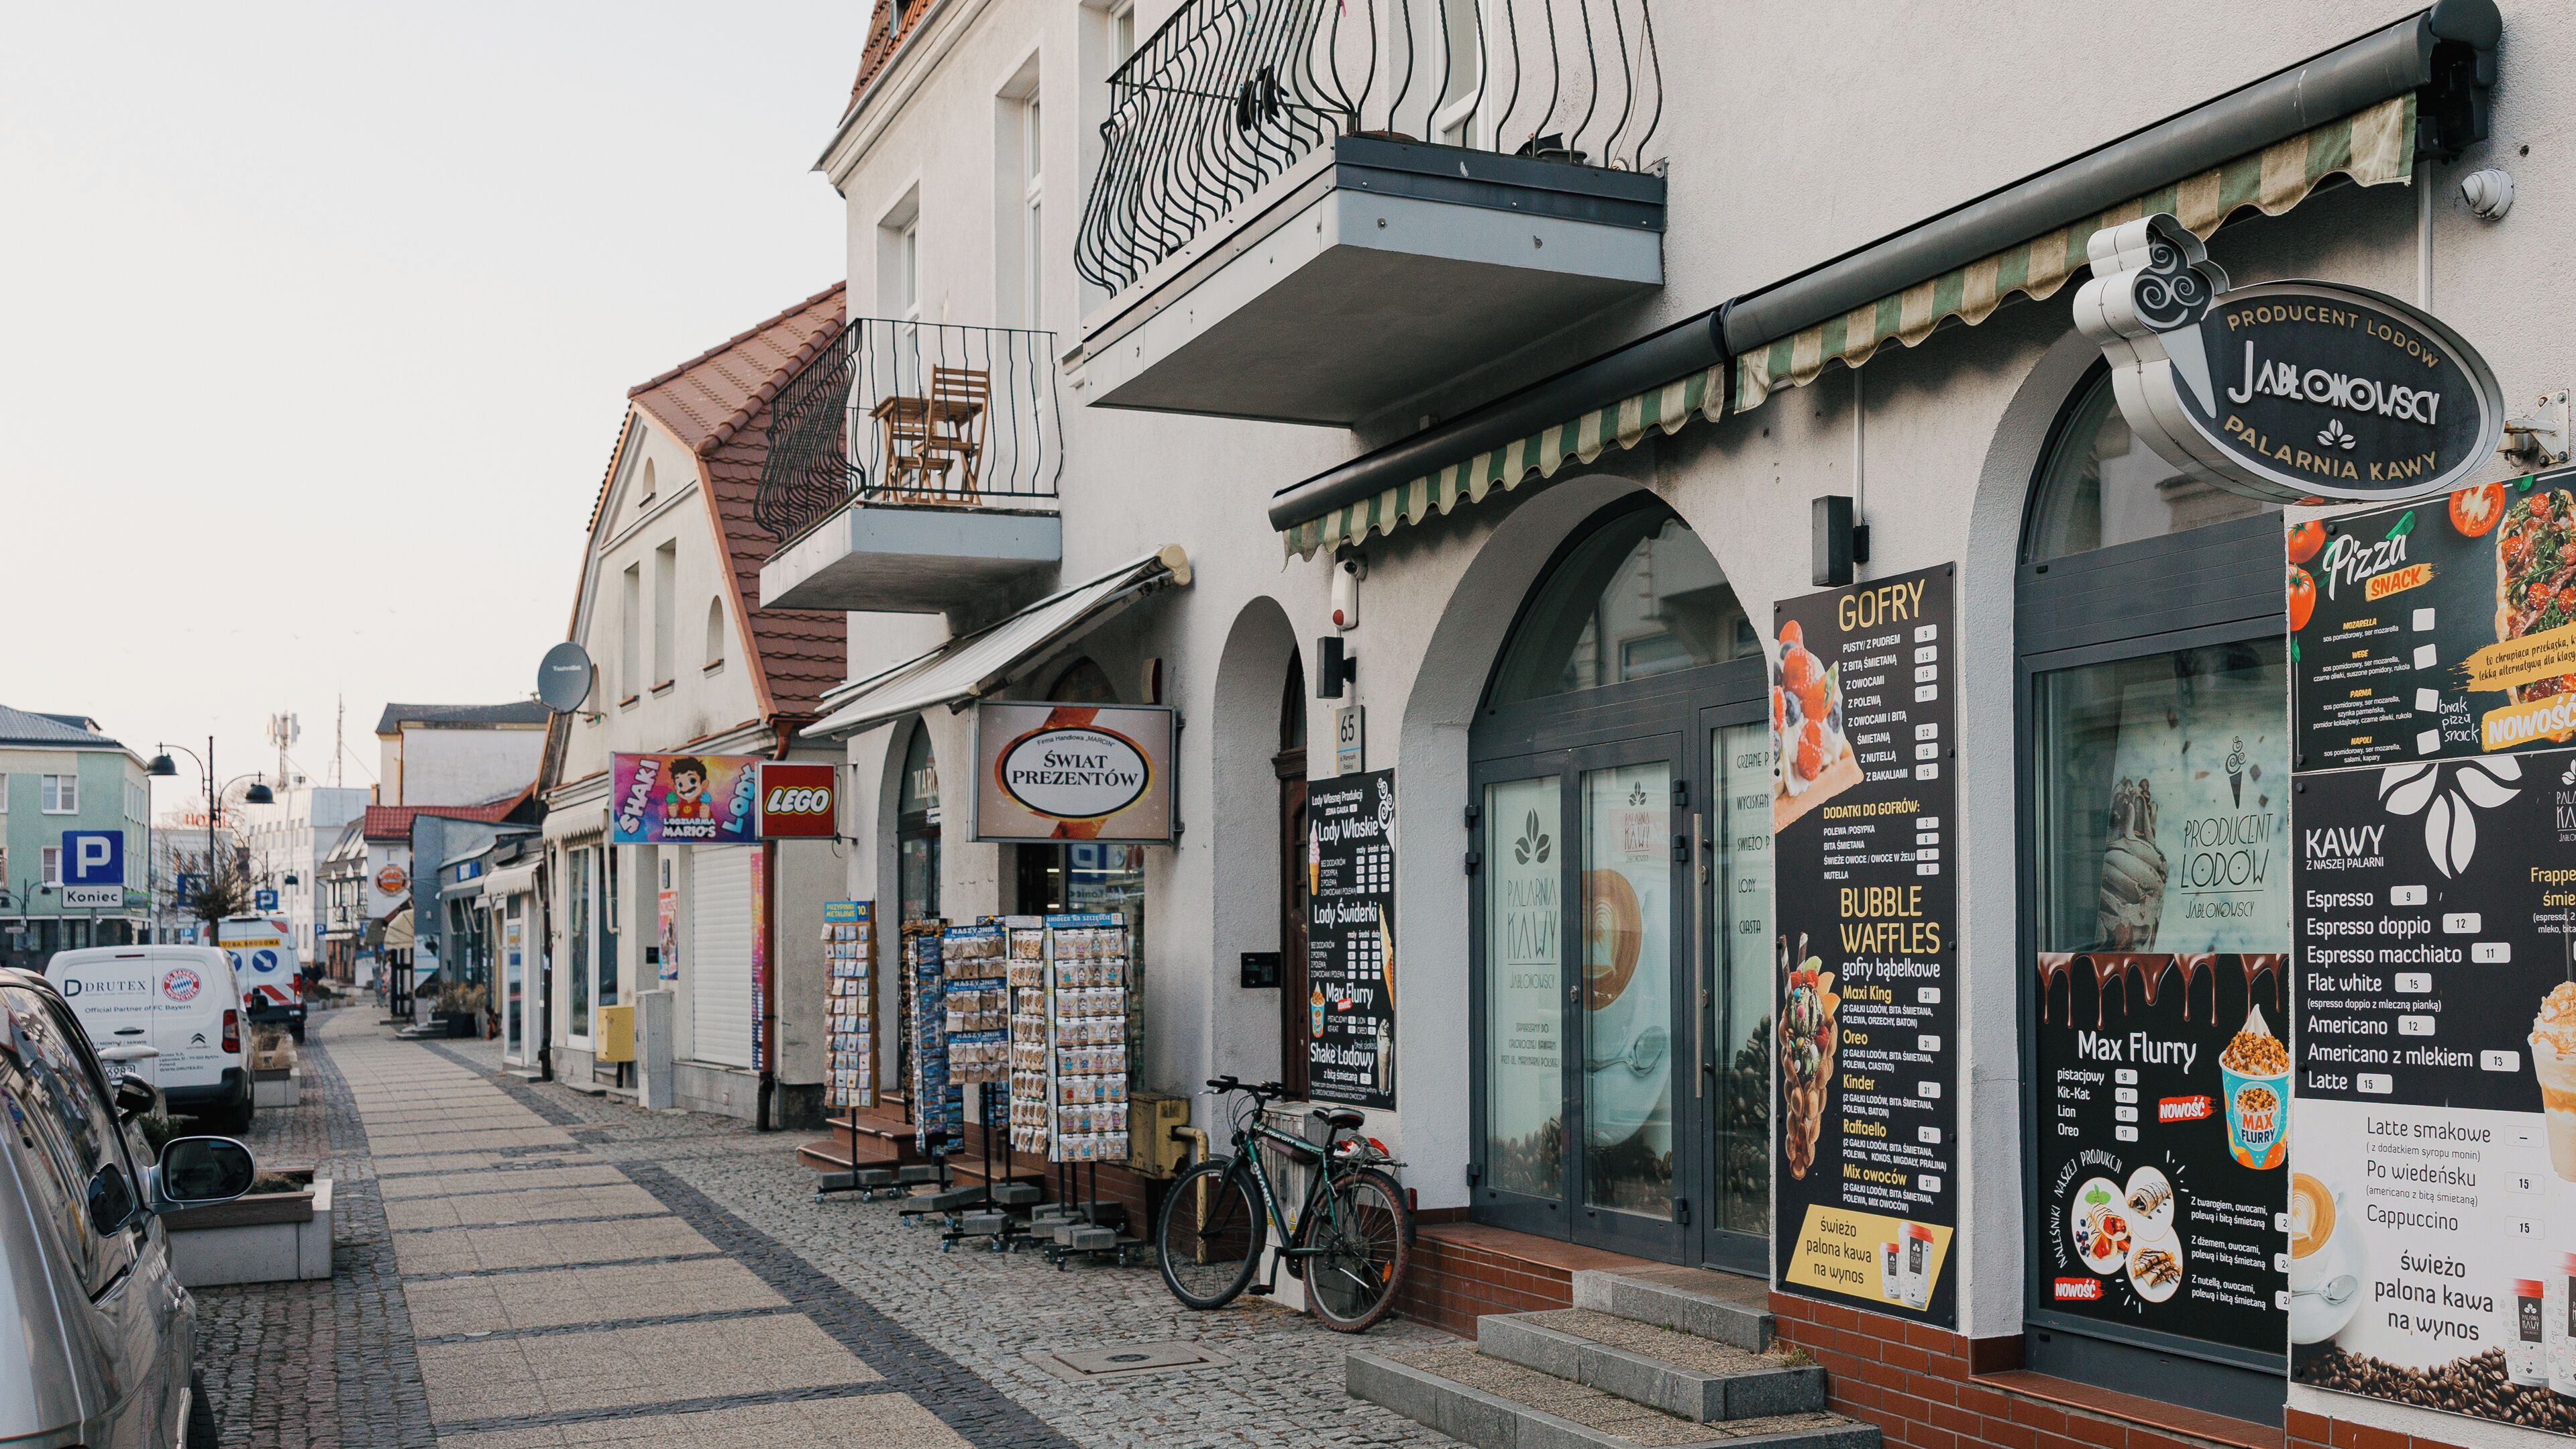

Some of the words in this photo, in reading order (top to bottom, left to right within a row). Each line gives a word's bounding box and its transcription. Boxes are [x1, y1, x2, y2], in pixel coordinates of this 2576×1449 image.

[2227, 305, 2359, 331] PRODUCENT
[2367, 318, 2441, 368] LODÓW
[2224, 415, 2359, 480] PALARNIA
[2369, 451, 2438, 480] KAWY
[2323, 535, 2406, 600] Pizza
[2371, 567, 2421, 596] SNACK
[1839, 579, 1925, 631] GOFRY
[2343, 618, 2377, 630] MOZARELLA
[2374, 626, 2398, 636] mozarella
[1843, 663, 1847, 672] Z
[1849, 659, 1862, 672] BITĄ
[1864, 653, 1897, 668] ŚMIETANĄ
[2352, 649, 2369, 659] WEGE
[2486, 655, 2493, 665] to
[2496, 649, 2529, 662] chrupiąca
[2532, 639, 2569, 655] przekąska,
[1846, 681, 1851, 690] Z
[1851, 676, 1884, 689] OWOCAMI
[2351, 688, 2371, 698] PARMA
[1341, 714, 1354, 743] 65
[2489, 694, 2576, 744] NOWOŚĆ
[1037, 737, 1054, 747] Firma
[2351, 737, 2372, 745] NAPOLI
[2445, 723, 2479, 743] snack
[1044, 750, 1108, 769] ŚWIAT
[1012, 769, 1138, 787] PREZENTÓW
[619, 759, 661, 835] SHAKI
[721, 762, 755, 834] LODY
[766, 788, 831, 813] LEGO
[1312, 794, 1322, 807] Lody
[1824, 805, 1861, 819] DODATKI
[1863, 804, 1876, 816] DO
[1878, 797, 1920, 814] GOFRÓW:
[662, 826, 716, 837] MARIO'S
[1318, 820, 1340, 846] Lody
[1342, 816, 1378, 839] Włoskie
[2184, 813, 2273, 848] PRODUCENT
[2306, 824, 2385, 859] KAWY
[76, 836, 111, 878] P
[2306, 861, 2312, 870] Z
[2314, 859, 2345, 871] NASZEJ
[2347, 857, 2384, 868] PALARNI
[1824, 871, 1848, 879] NUTELLA
[2181, 849, 2269, 888] LODÓW
[2531, 867, 2576, 885] Frappe
[1507, 877, 1557, 907] PALARNIA
[1738, 878, 1756, 893] LODY
[67, 891, 118, 903] Koniec
[1841, 886, 1922, 917] BUBBLE
[2307, 890, 2373, 912] Espresso
[2406, 892, 2411, 901] 9
[1314, 903, 1336, 928] Lody
[1337, 898, 1377, 923] Świderki
[1507, 910, 1557, 959] KAWY
[1739, 920, 1761, 934] CIASTA
[1840, 922, 1940, 954] WAFFLES
[2308, 918, 2373, 939] Espresso
[2379, 916, 2430, 938] doppio
[2456, 919, 2466, 928] 12
[2308, 945, 2374, 968] Espresso
[2379, 944, 2462, 963] macchiato
[2485, 949, 2494, 958] 11
[1843, 957, 1872, 981] gofry
[1876, 957, 1940, 982] bąbelkowe
[85, 981, 146, 992] DRUTEX
[2308, 973, 2335, 992] Flat
[2340, 973, 2381, 991] white
[2410, 979, 2418, 989] 15
[1326, 982, 1344, 1002] Max
[1346, 982, 1373, 1010] Flurry
[1843, 985, 1866, 1000] Maxi
[1870, 985, 1892, 1004] King
[2308, 999, 2343, 1010] (espresso
[2345, 1000, 2369, 1010] doppio
[2379, 1000, 2410, 1012] mleczną
[2413, 999, 2441, 1012] pianką)
[2308, 1015, 2387, 1035] Americano
[2408, 1022, 2418, 1031] 12
[1843, 1030, 1868, 1044] Oreo
[1311, 1042, 1336, 1064] Shake
[1338, 1044, 1373, 1073] Lodowy
[2078, 1030, 2122, 1061] Max
[2130, 1031, 2196, 1074] Flurry
[2308, 1043, 2387, 1064] Americano
[2393, 1051, 2401, 1064] z
[2406, 1046, 2473, 1067] mlekiem
[2493, 1057, 2502, 1066] 13
[1843, 1074, 1874, 1090] Kinder
[2057, 1069, 2104, 1085] pistacjowy
[2121, 1073, 2127, 1081] 19
[2308, 1071, 2347, 1090] Latte
[2364, 1080, 2373, 1089] 15
[2058, 1086, 2090, 1100] Kit-Kat
[2058, 1105, 2076, 1118] Lion
[2159, 1097, 2204, 1119] NOWOŚĆ
[1843, 1119, 1886, 1137] Raffaello
[2058, 1123, 2079, 1136] Oreo
[2243, 1112, 2273, 1130] MAX
[2367, 1116, 2408, 1137] Latte
[2414, 1122, 2491, 1143] smakowe
[2241, 1128, 2275, 1144] FLURRY
[2080, 1148, 2123, 1174] PRODUKCJI
[1843, 1163, 1860, 1179] Mix
[1864, 1168, 1907, 1185] owoców
[2053, 1159, 2078, 1198] NASZEJ
[2367, 1160, 2385, 1179] Po
[2392, 1164, 2476, 1187] wiedeńsku
[2519, 1179, 2529, 1189] 15
[1821, 1216, 1856, 1237] świeżo
[2367, 1204, 2458, 1231] Cappuccino
[2519, 1223, 2530, 1233] 15
[2049, 1205, 2068, 1269] NALEŚNIKI
[1807, 1238, 1840, 1257] palona
[1844, 1242, 1871, 1263] kawa
[1814, 1263, 1826, 1276] na
[1829, 1266, 1864, 1284] wynos
[2401, 1248, 2465, 1278] świeżo
[2055, 1279, 2096, 1299] NOWOŚĆ
[2375, 1278, 2435, 1304] palona
[2444, 1284, 2493, 1312] kawa
[2389, 1311, 2409, 1330] na
[2416, 1317, 2479, 1341] wynos
